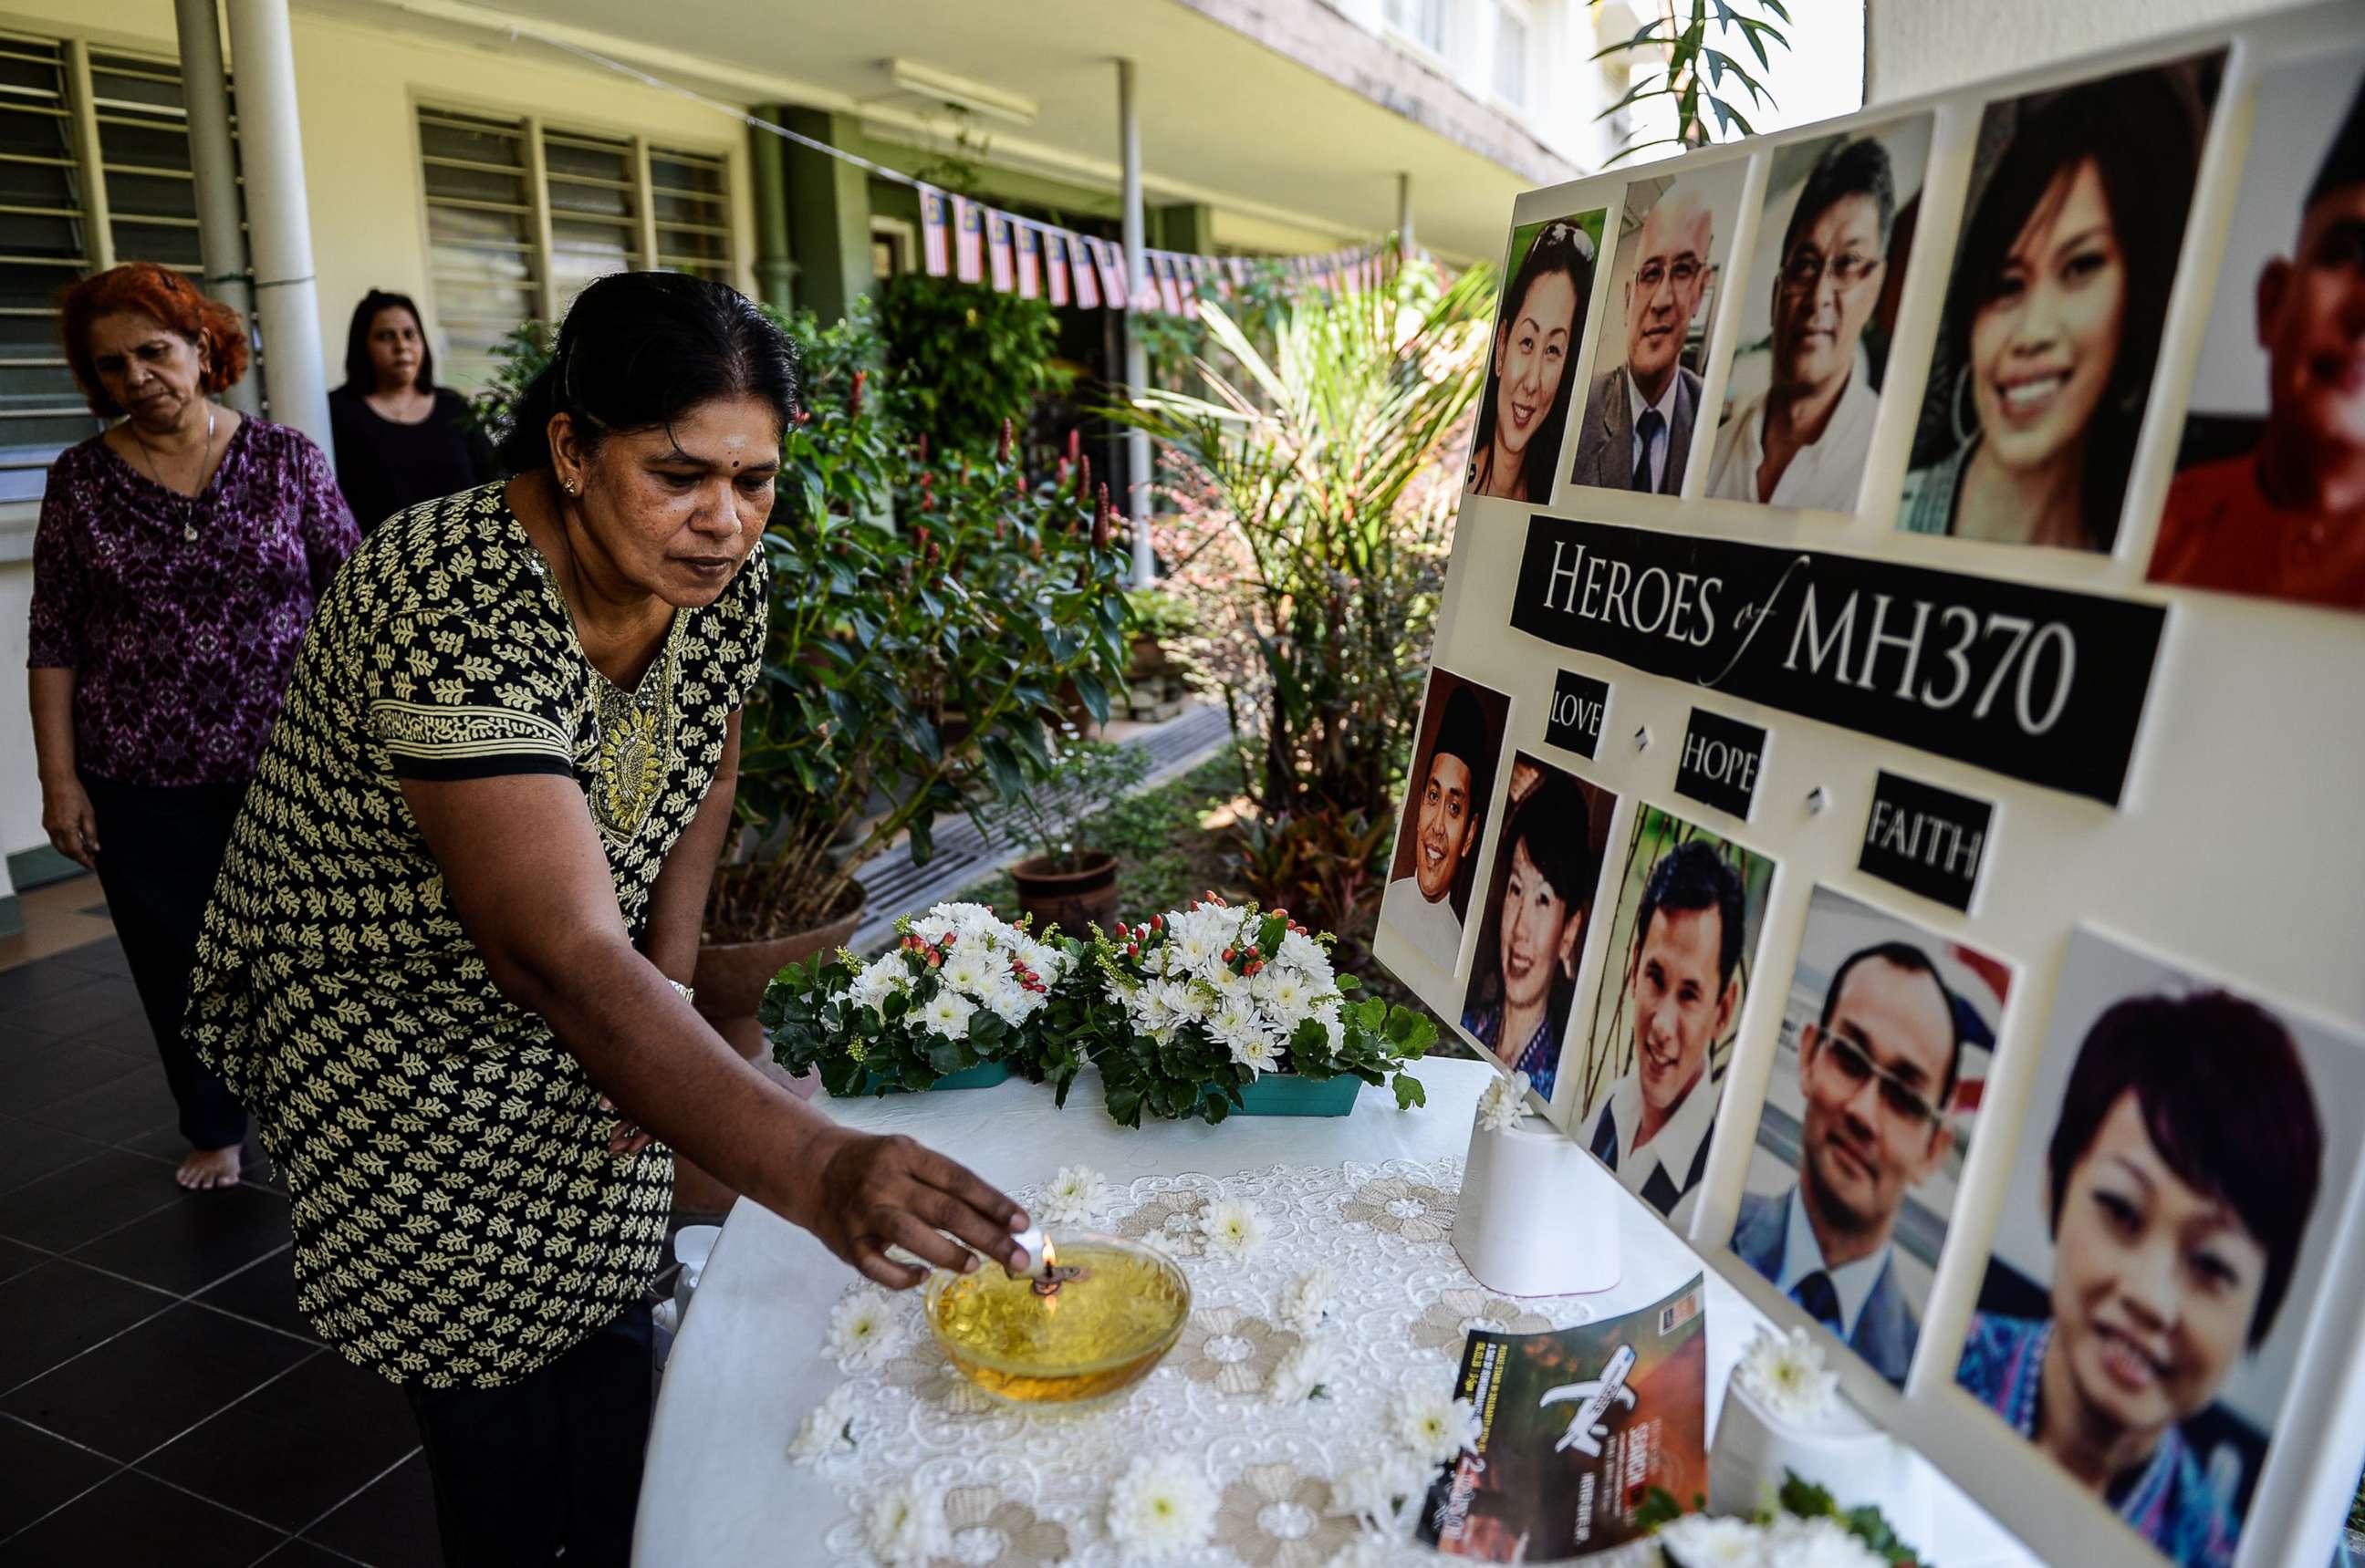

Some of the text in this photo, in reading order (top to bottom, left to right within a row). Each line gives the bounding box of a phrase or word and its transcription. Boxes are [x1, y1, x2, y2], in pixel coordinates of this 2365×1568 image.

[1697, 555, 1809, 686] of
[1782, 582, 2076, 735] MH370
[1550, 691, 1602, 737] LOVE
[1682, 732, 1759, 792] HOPE
[1868, 799, 1984, 880] FAITH
